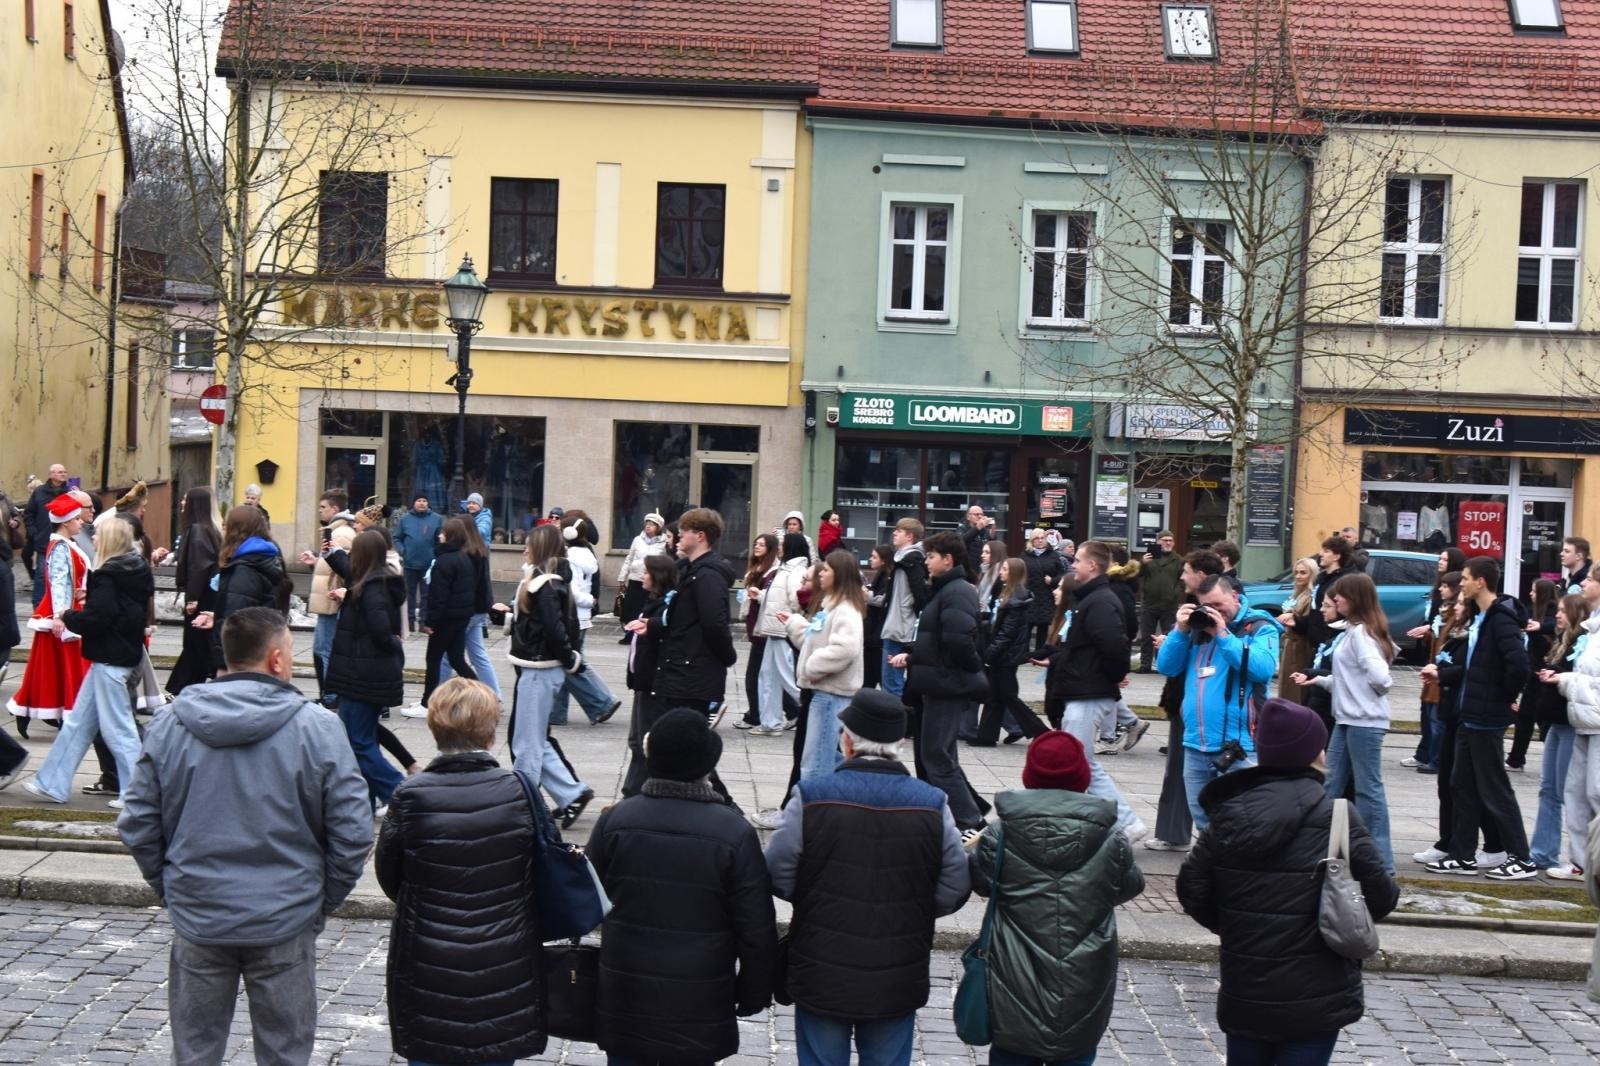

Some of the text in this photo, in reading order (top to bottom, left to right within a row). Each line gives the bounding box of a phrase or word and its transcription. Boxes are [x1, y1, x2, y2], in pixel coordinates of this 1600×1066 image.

[281, 289, 750, 341] MARKE KRYSTYNA
[341, 367, 350, 379] 5
[854, 397, 894, 409] ZŁOTO
[853, 408, 894, 417] SREBRO
[914, 405, 1016, 425] LOOMBARD
[852, 416, 894, 425] KONSOLE
[1446, 418, 1504, 442] Zuzi
[1464, 511, 1501, 522] STOP!
